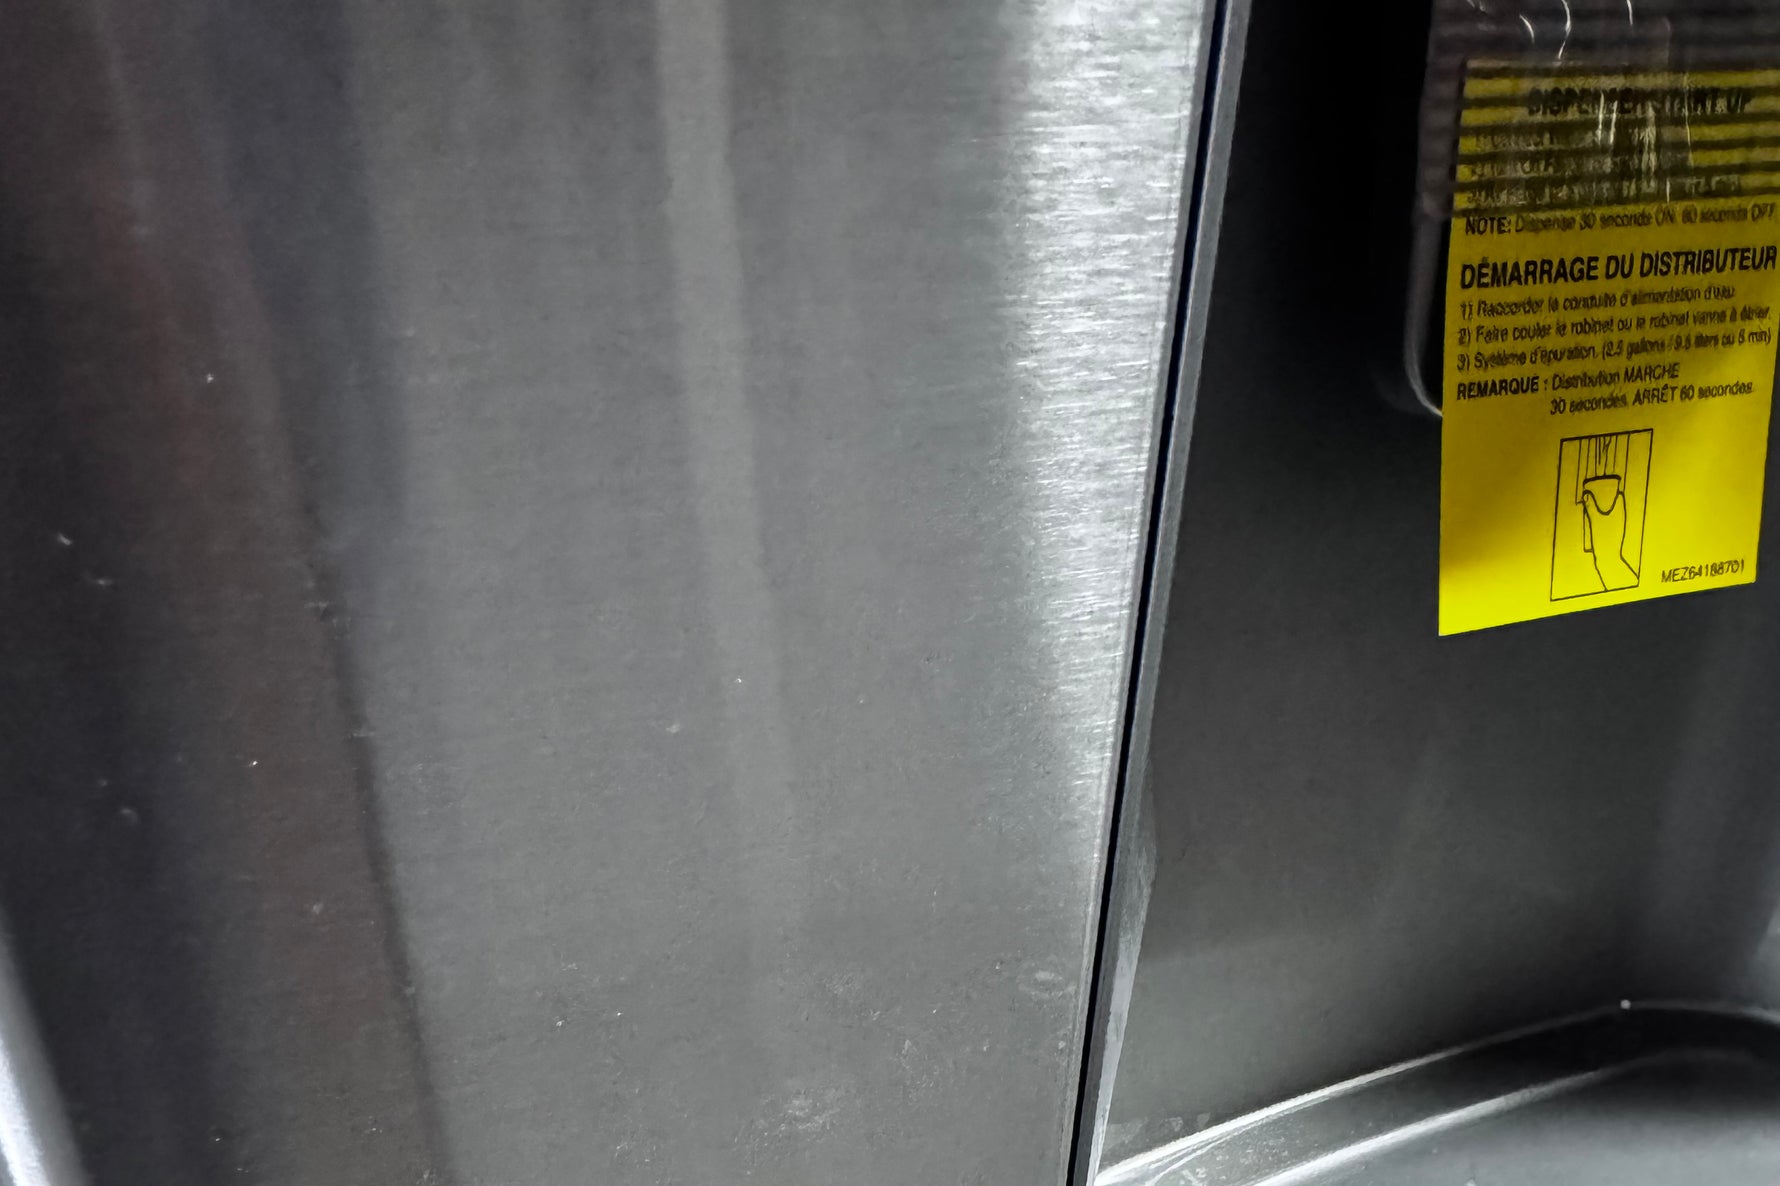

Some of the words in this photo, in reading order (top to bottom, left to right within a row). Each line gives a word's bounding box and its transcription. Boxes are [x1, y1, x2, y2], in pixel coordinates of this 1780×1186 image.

[1461, 256, 1599, 289] DÉMARRAGE
[1605, 252, 1634, 279] DU
[1639, 245, 1777, 277] DISTRIBUTEUR
[1618, 318, 1632, 331] ou
[1457, 376, 1539, 400] REMARQUE
[1552, 369, 1620, 391] Distribution
[1624, 362, 1680, 383] MARCHE
[1550, 396, 1566, 415] 30
[1632, 383, 1678, 406] ARRÊT
[1680, 384, 1694, 402] 60
[1698, 380, 1753, 400] secondes
